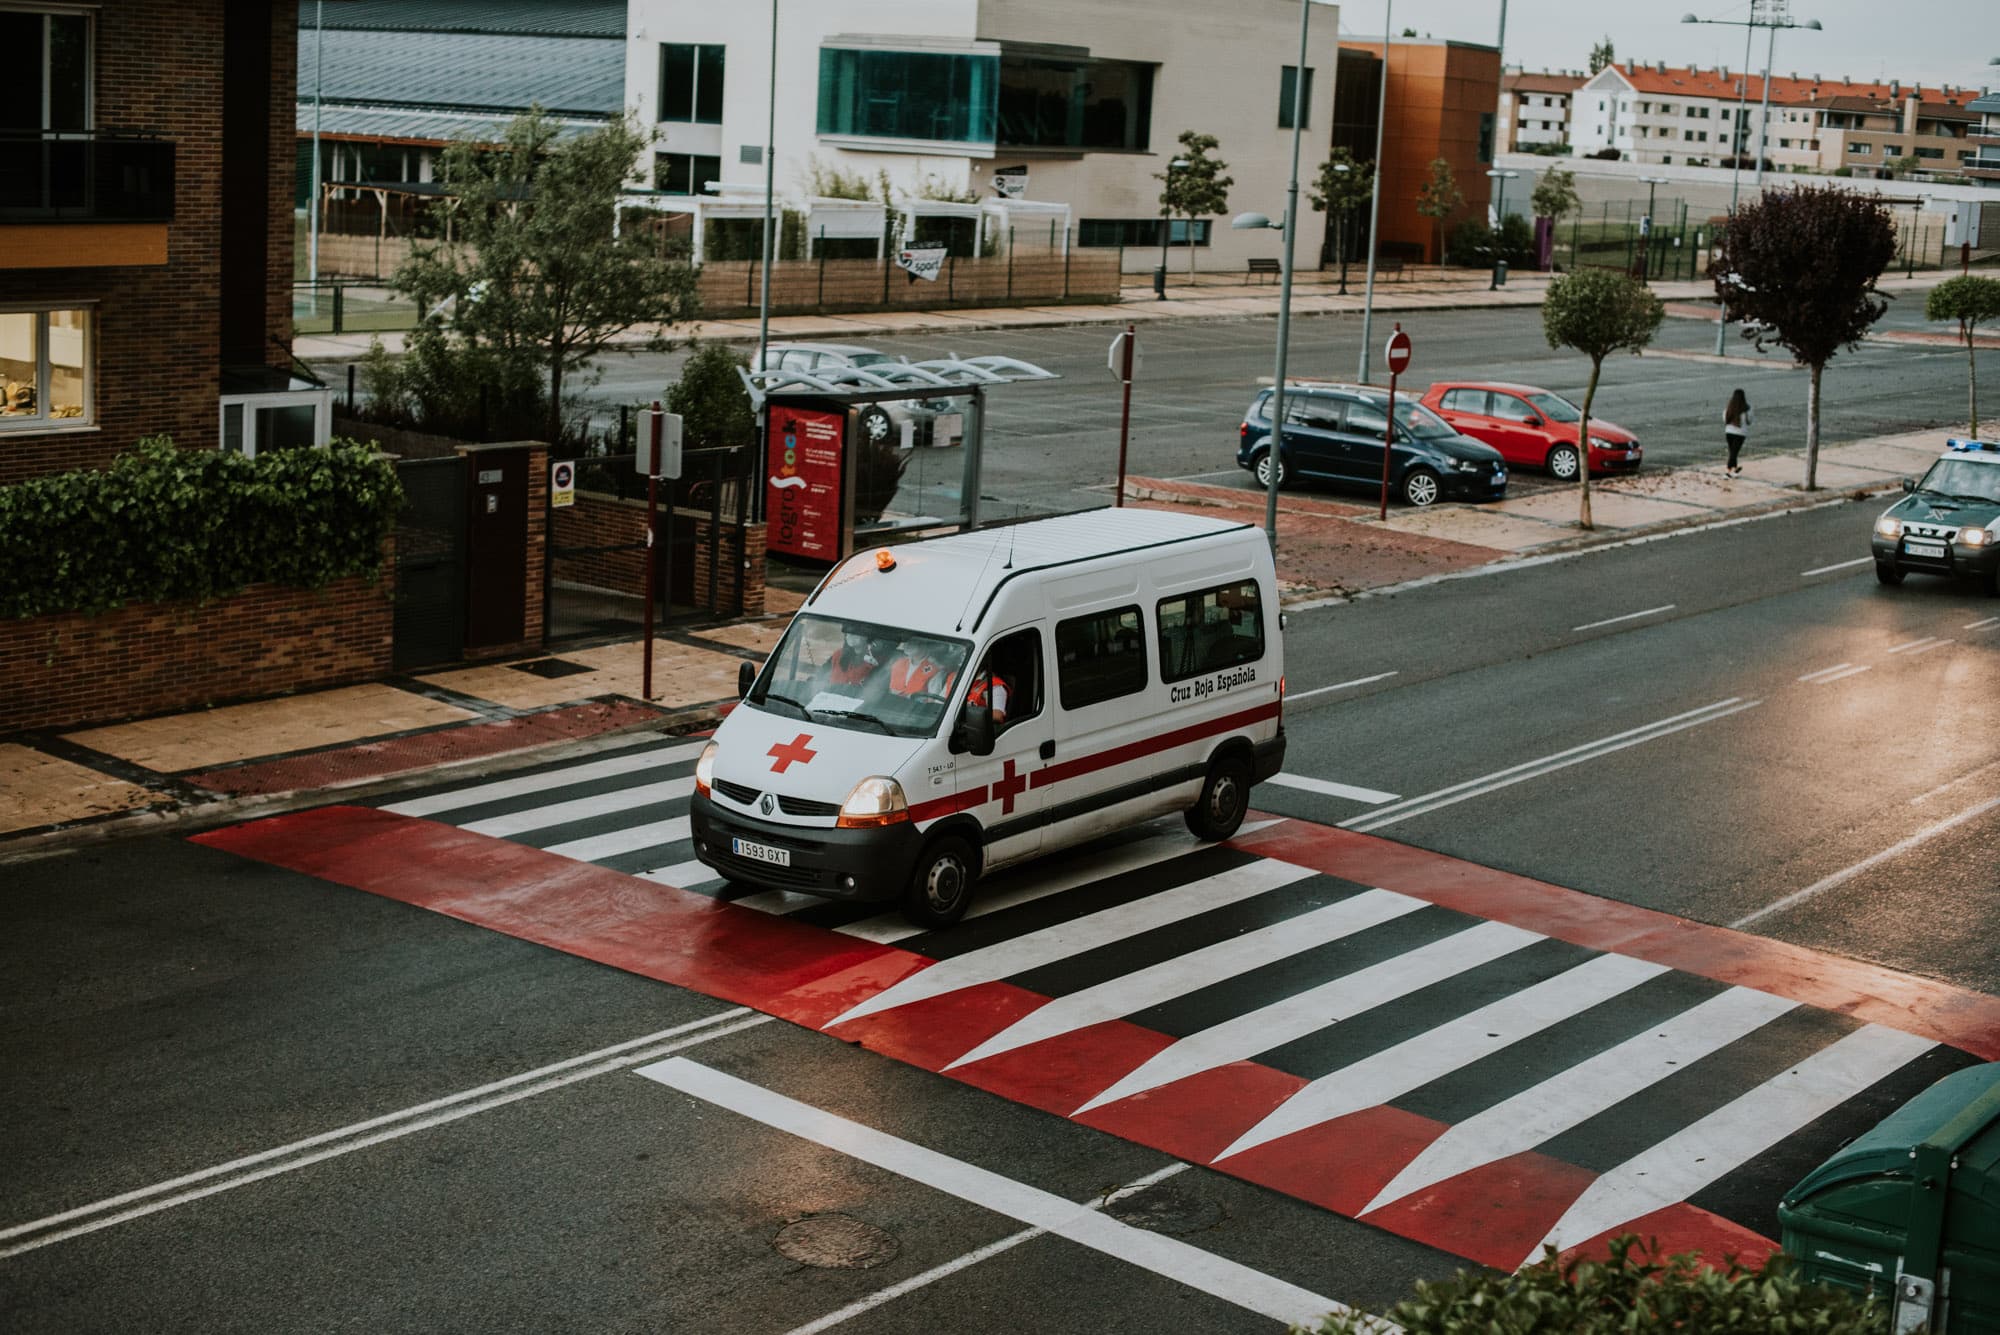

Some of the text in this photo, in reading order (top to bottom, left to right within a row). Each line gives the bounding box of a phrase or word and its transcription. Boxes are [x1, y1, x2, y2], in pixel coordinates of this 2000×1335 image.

[915, 260, 939, 272] sport
[1171, 667, 1256, 703] Cruz Roja Española
[740, 841, 787, 864] 1593 GXT
